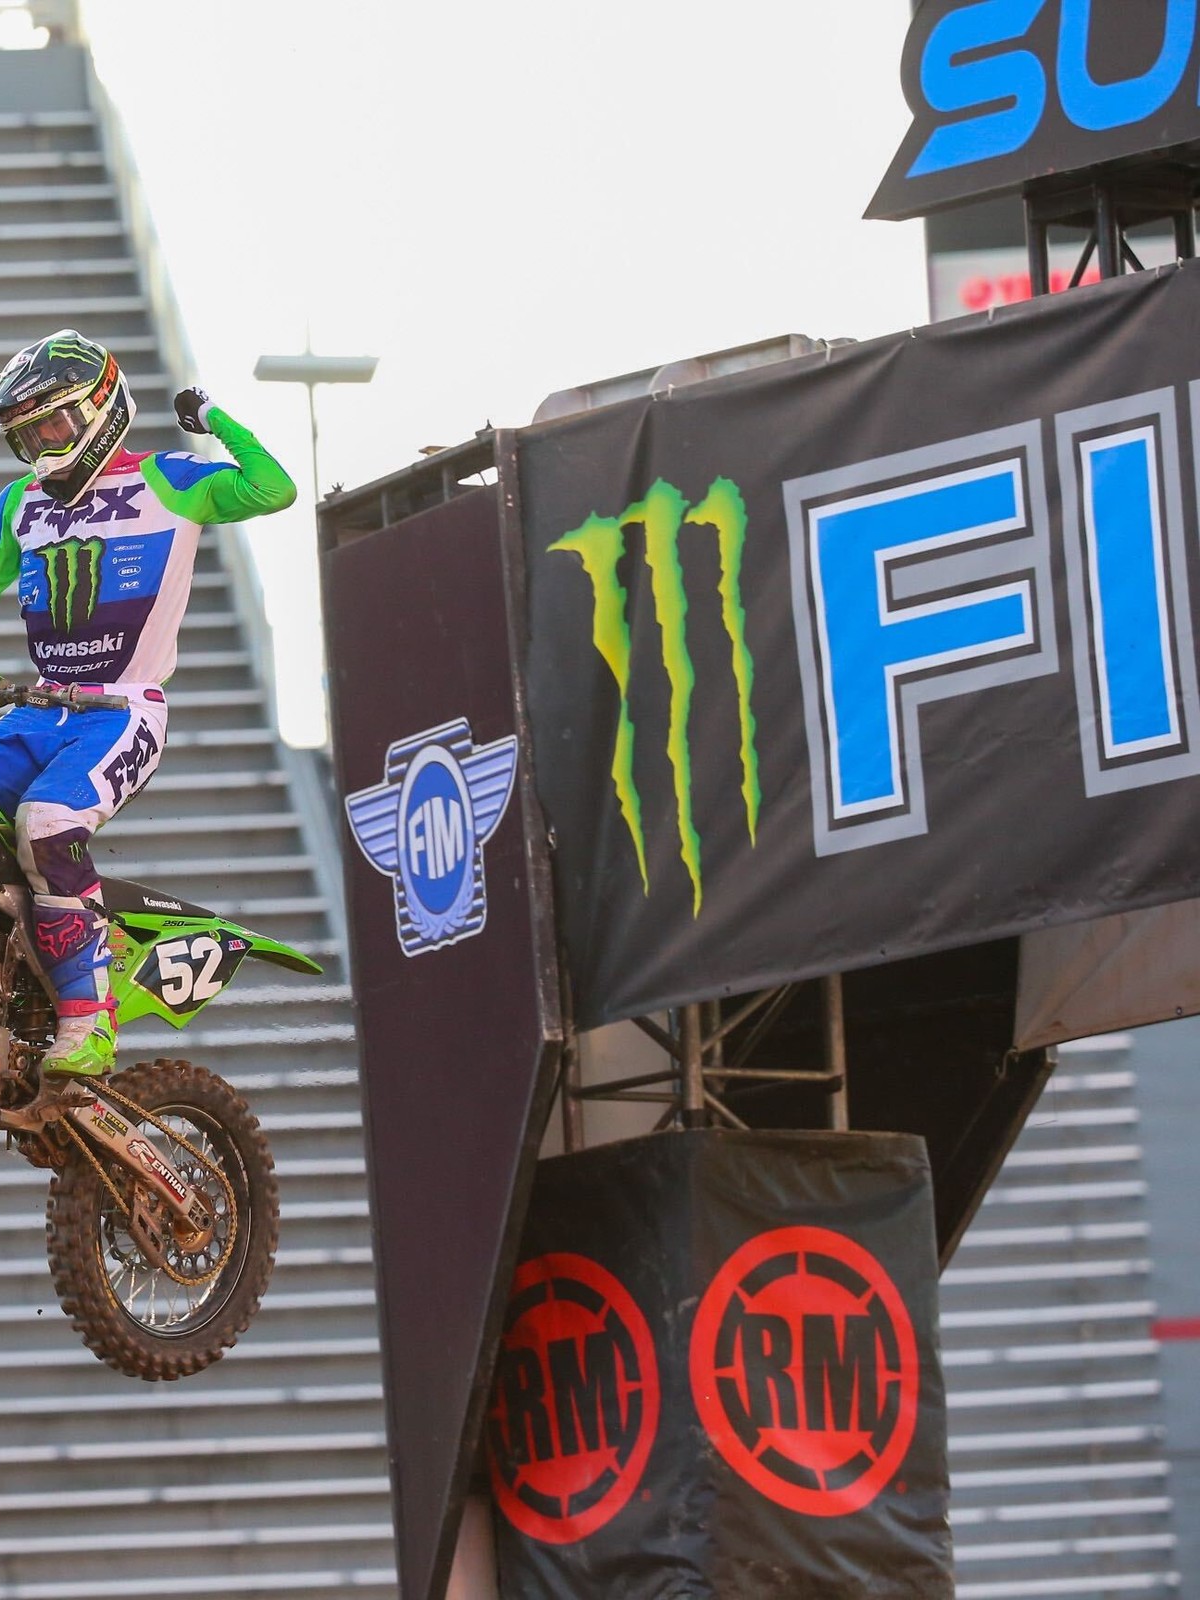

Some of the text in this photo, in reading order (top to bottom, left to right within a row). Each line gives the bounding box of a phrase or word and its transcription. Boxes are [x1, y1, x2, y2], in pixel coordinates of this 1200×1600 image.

[904, 0, 1200, 179] SU
[120, 567, 138, 575] BELL
[33, 631, 125, 660] Kawasaki
[783, 382, 1200, 858] FI
[57, 659, 114, 674] CIRCUIT
[408, 796, 465, 880] FIM
[142, 896, 183, 912] Kawasaki
[155, 936, 224, 1006] 52
[105, 1112, 128, 1133] EXCEL
[504, 1332, 624, 1463] RM
[742, 1313, 878, 1432] RM
